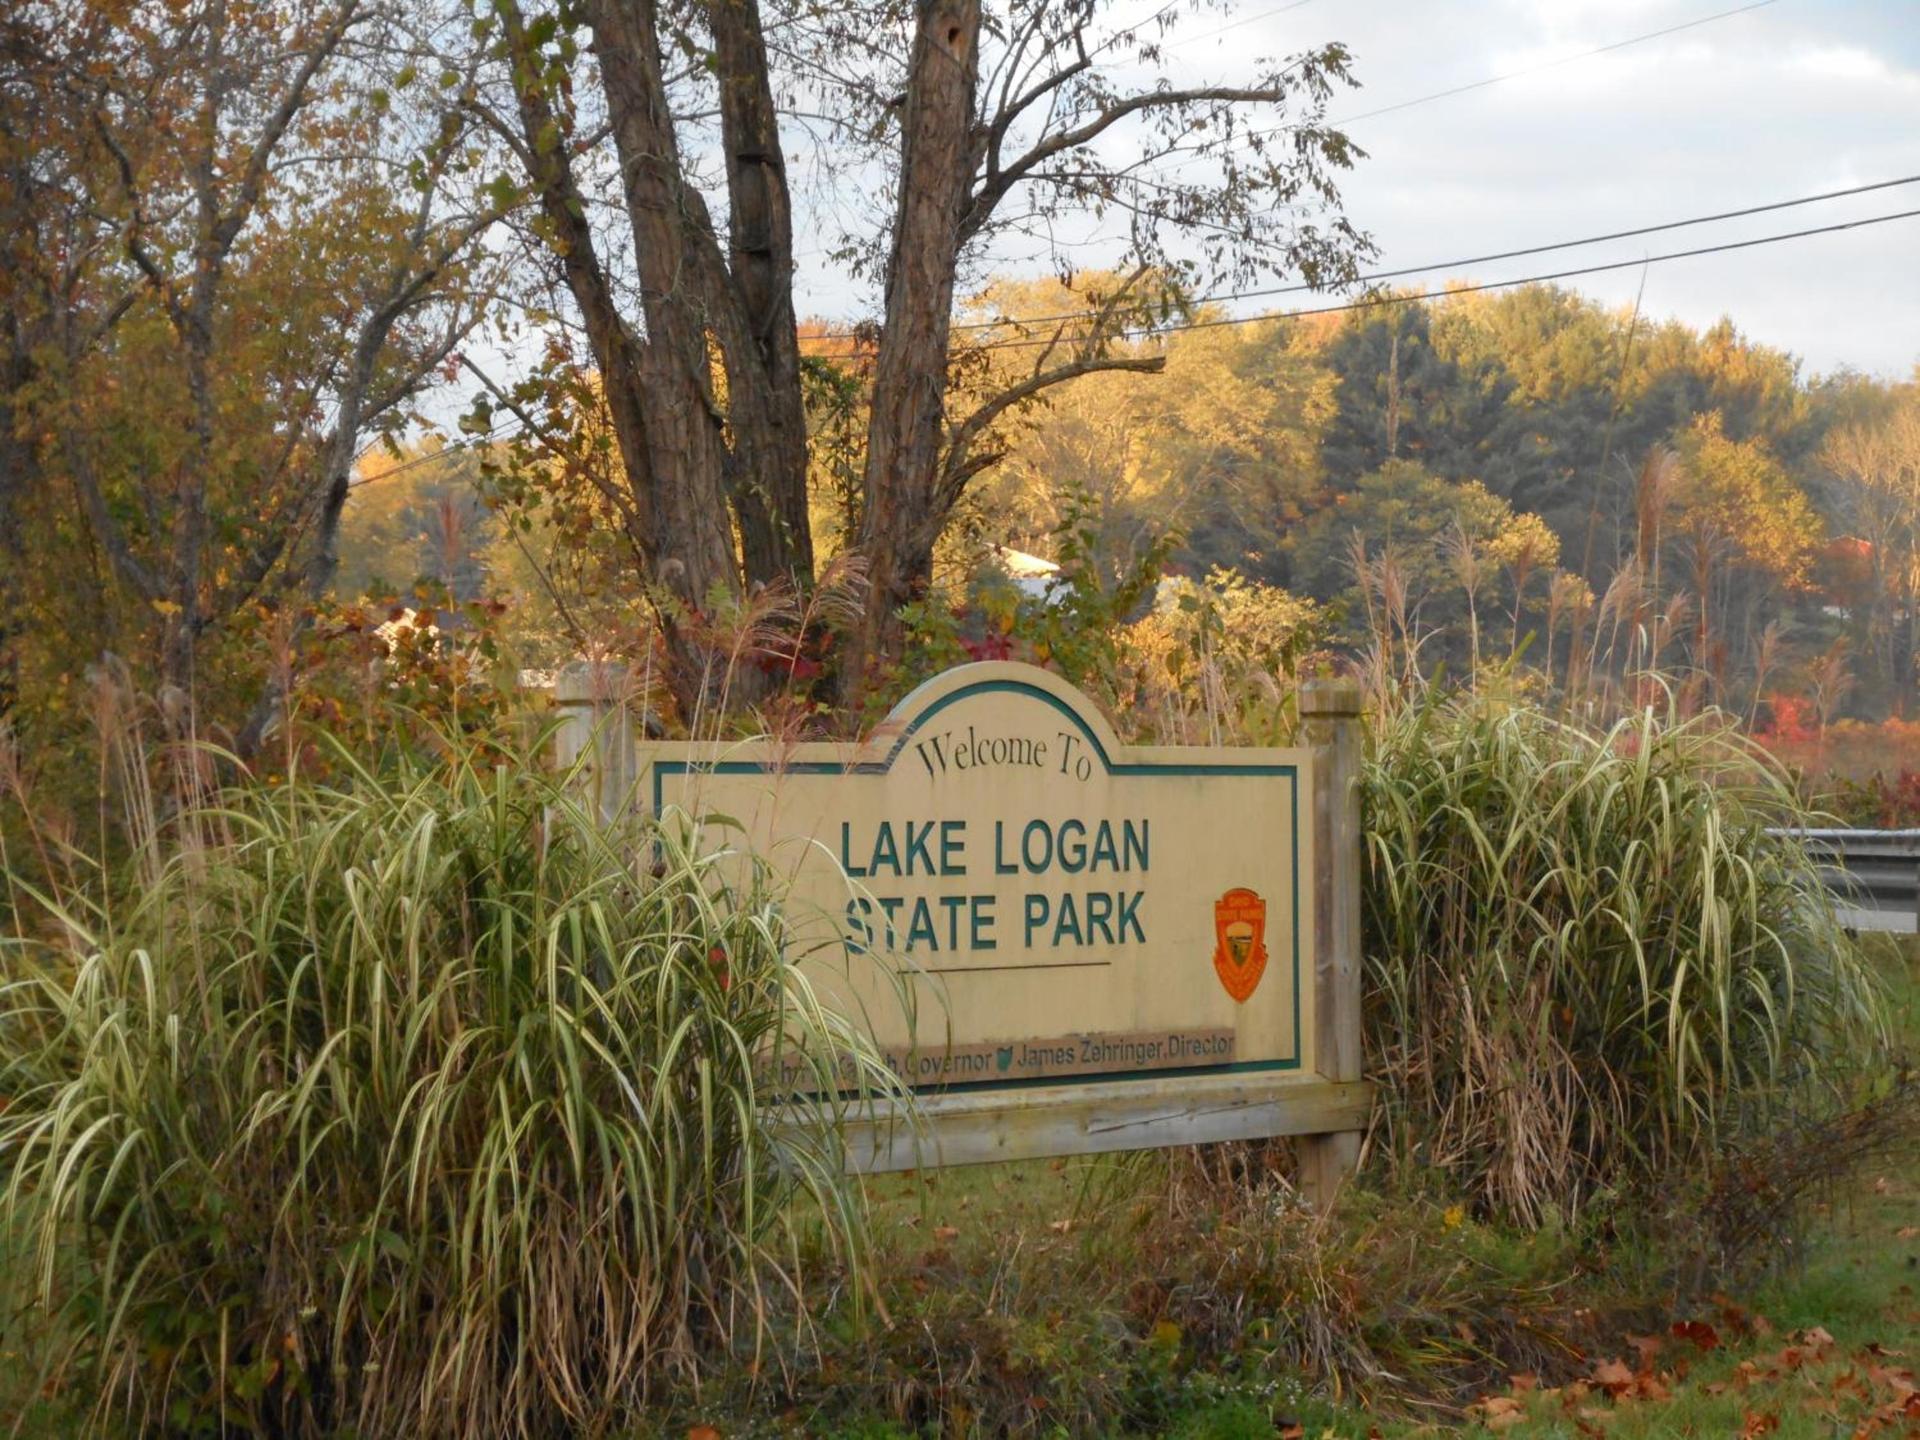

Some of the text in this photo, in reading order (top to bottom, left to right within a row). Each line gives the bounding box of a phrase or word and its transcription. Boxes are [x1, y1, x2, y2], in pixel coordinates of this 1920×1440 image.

[916, 726, 1091, 782] Welcome To
[842, 818, 1149, 877] LAKE LOGAN
[845, 895, 997, 955] STATE
[1024, 891, 1146, 948] PARK
[1017, 1044, 1075, 1068] James
